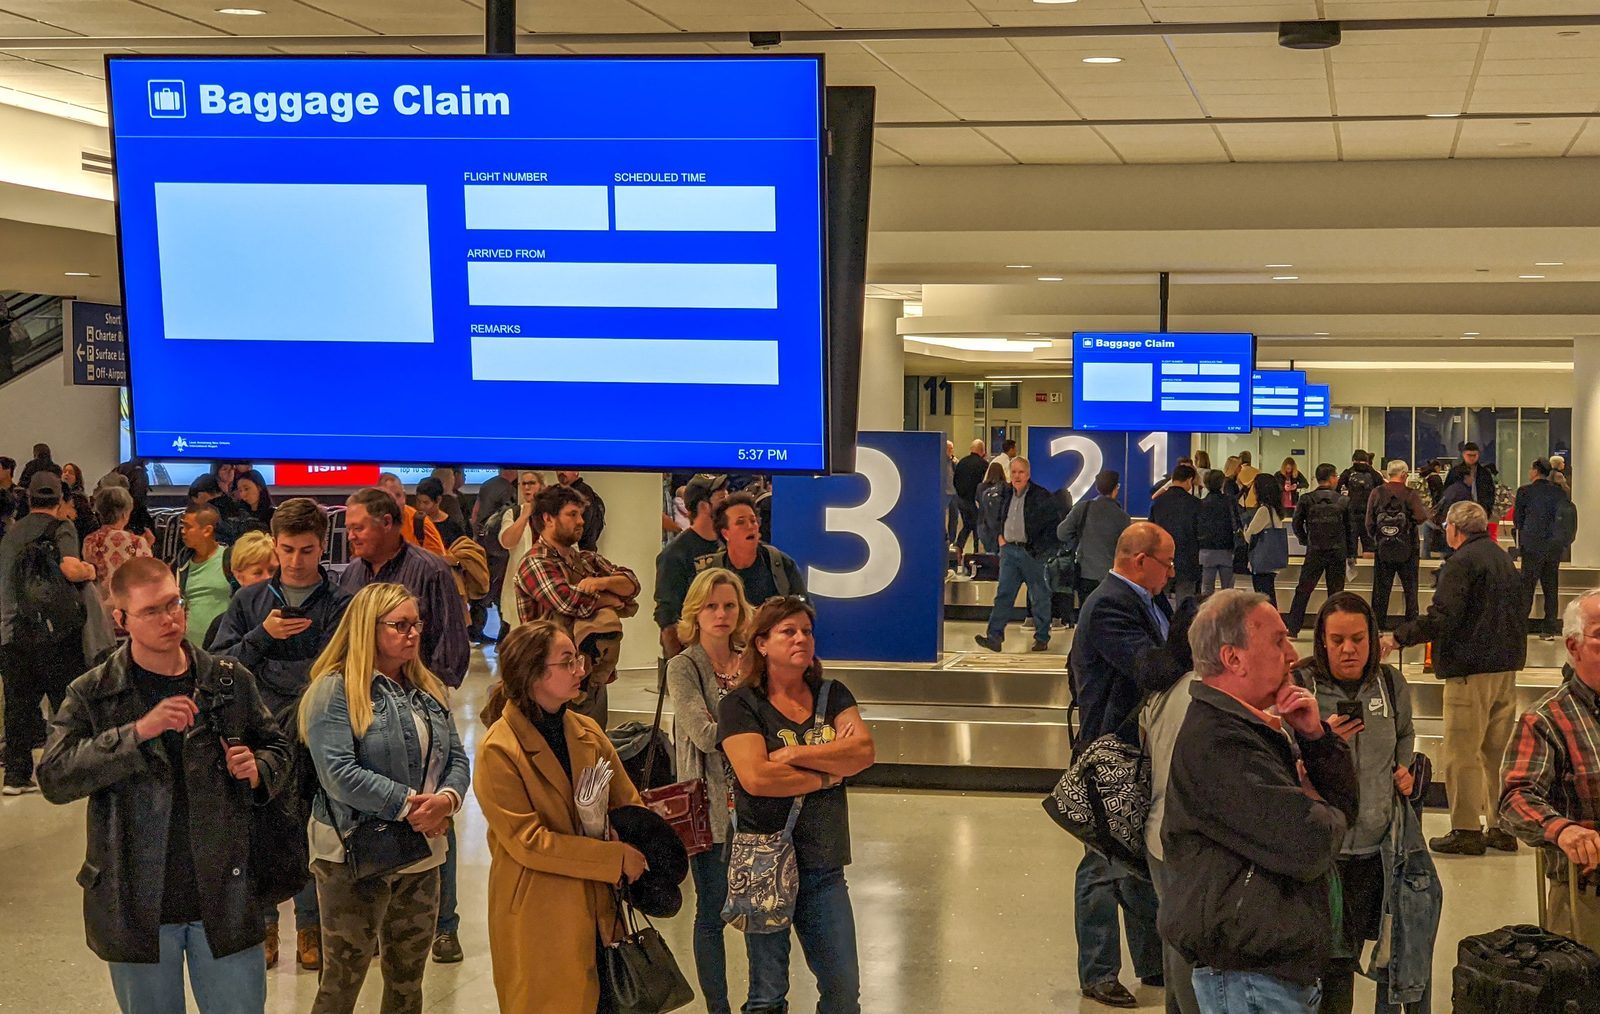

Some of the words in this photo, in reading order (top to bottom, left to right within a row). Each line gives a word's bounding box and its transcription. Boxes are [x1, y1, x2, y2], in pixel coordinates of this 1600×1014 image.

[199, 84, 380, 123] Baggage
[393, 84, 510, 116] Claim
[463, 172, 500, 182] FLIGHT
[502, 172, 548, 182] NUMBER
[614, 173, 679, 182] SCHEDULED
[681, 173, 706, 182] TIME
[467, 249, 513, 258] ARRIVED
[515, 249, 546, 259] FROM
[105, 313, 121, 325] Short
[95, 329, 117, 342] Charter
[470, 324, 521, 334] REMARKS
[1096, 339, 1142, 349] Baggage
[1145, 339, 1175, 348] Claim
[95, 348, 117, 361] Surface
[923, 376, 952, 416] 11
[738, 448, 764, 461] 5:37
[767, 449, 788, 461] PM
[1138, 432, 1168, 484] 1
[1050, 435, 1103, 506] 2
[807, 446, 902, 599] 3
